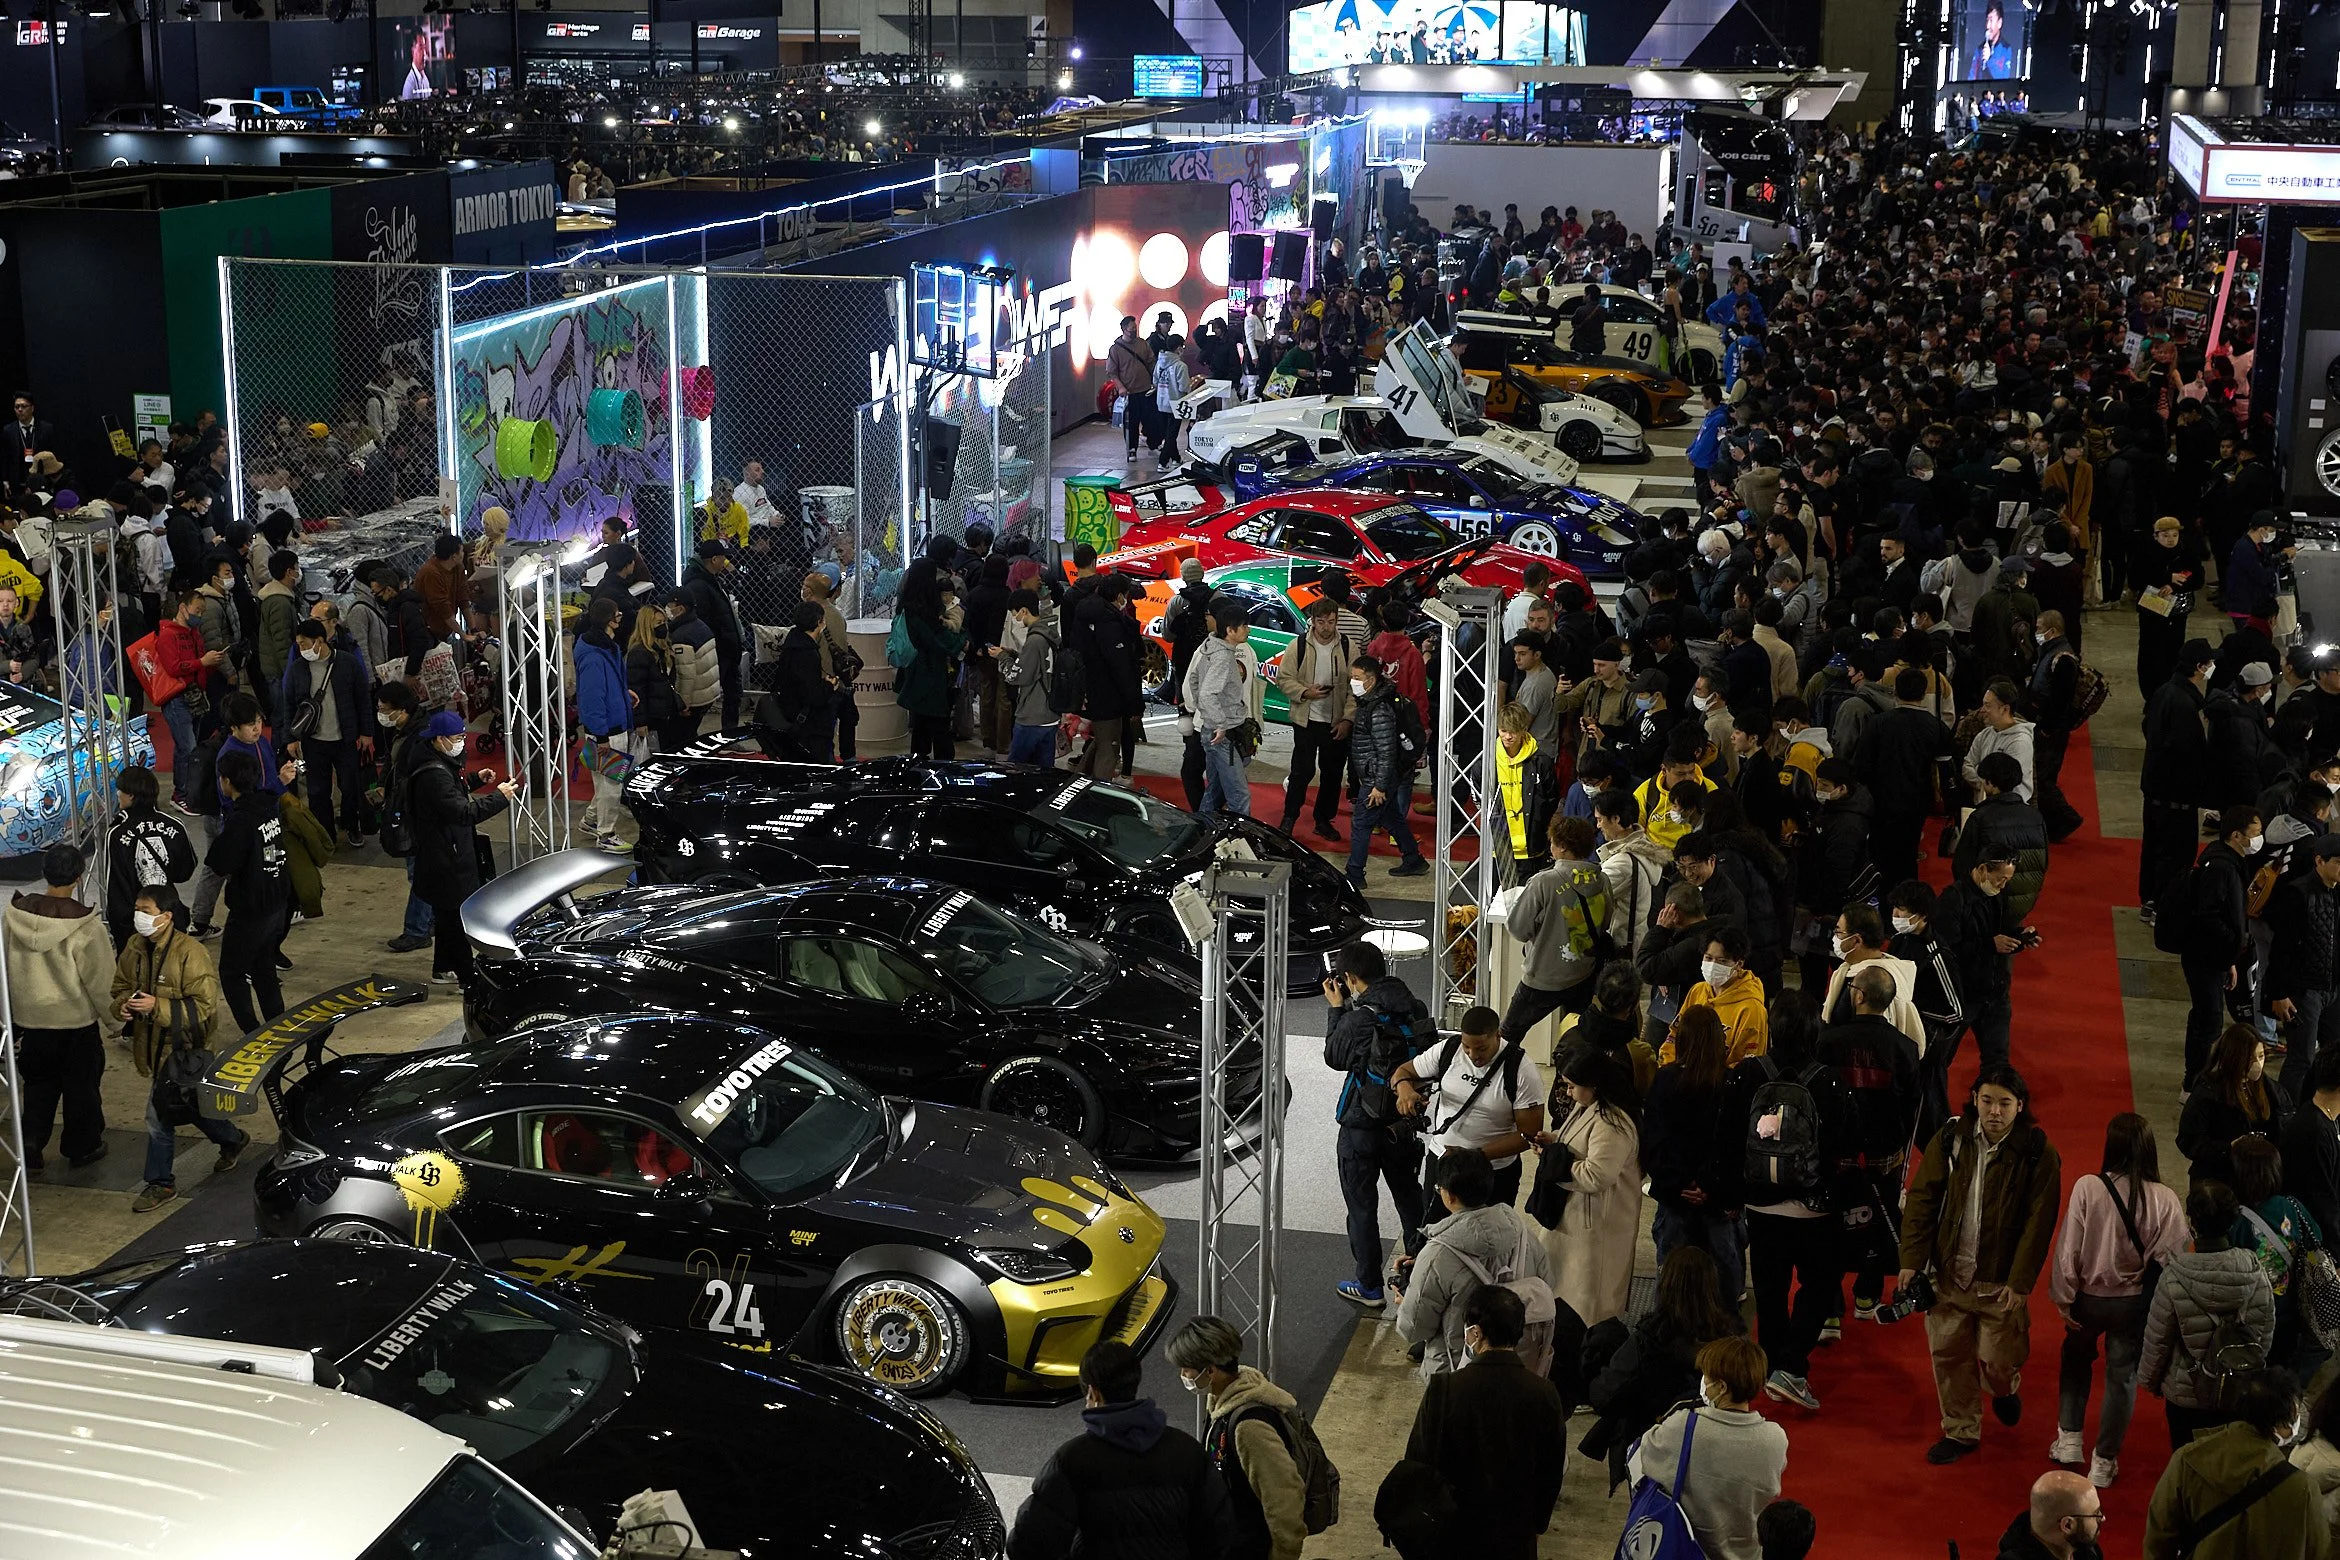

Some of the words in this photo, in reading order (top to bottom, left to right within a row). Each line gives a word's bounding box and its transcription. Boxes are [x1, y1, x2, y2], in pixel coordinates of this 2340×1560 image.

[717, 27, 761, 39] Garage
[1718, 152, 1740, 160] JOB
[1741, 153, 1771, 161] cars
[455, 192, 508, 236] ARMOR
[510, 183, 555, 225] TOKYO
[1623, 331, 1652, 360] 49
[1387, 384, 1419, 416] 41
[1460, 519, 1490, 538] 56
[872, 682, 893, 692] WAL
[1048, 786, 1080, 810] LIBERTY
[920, 902, 958, 938] LIBERTY
[948, 890, 975, 910] WALK
[657, 958, 688, 973] WALK
[514, 1013, 538, 1031] TOYO
[538, 1012, 568, 1022] TIRES
[215, 1018, 311, 1093] LIBERTY
[292, 981, 395, 1022] WALK
[690, 1070, 753, 1124] TOYO
[739, 1040, 793, 1078] TIRES
[990, 1063, 1013, 1084] TOYO
[1011, 1056, 1042, 1066] TIRES
[354, 1156, 392, 1172] LIBERTY
[390, 1162, 417, 1176] WALK
[418, 1161, 441, 1187] LB
[789, 1229, 818, 1240] MINI
[791, 1237, 816, 1247] GT
[706, 1279, 765, 1338] 24
[849, 1291, 893, 1339] LIBERTY
[891, 1292, 932, 1318] WALK
[364, 1306, 440, 1371] LIBERTY
[426, 1278, 478, 1312] WALK
